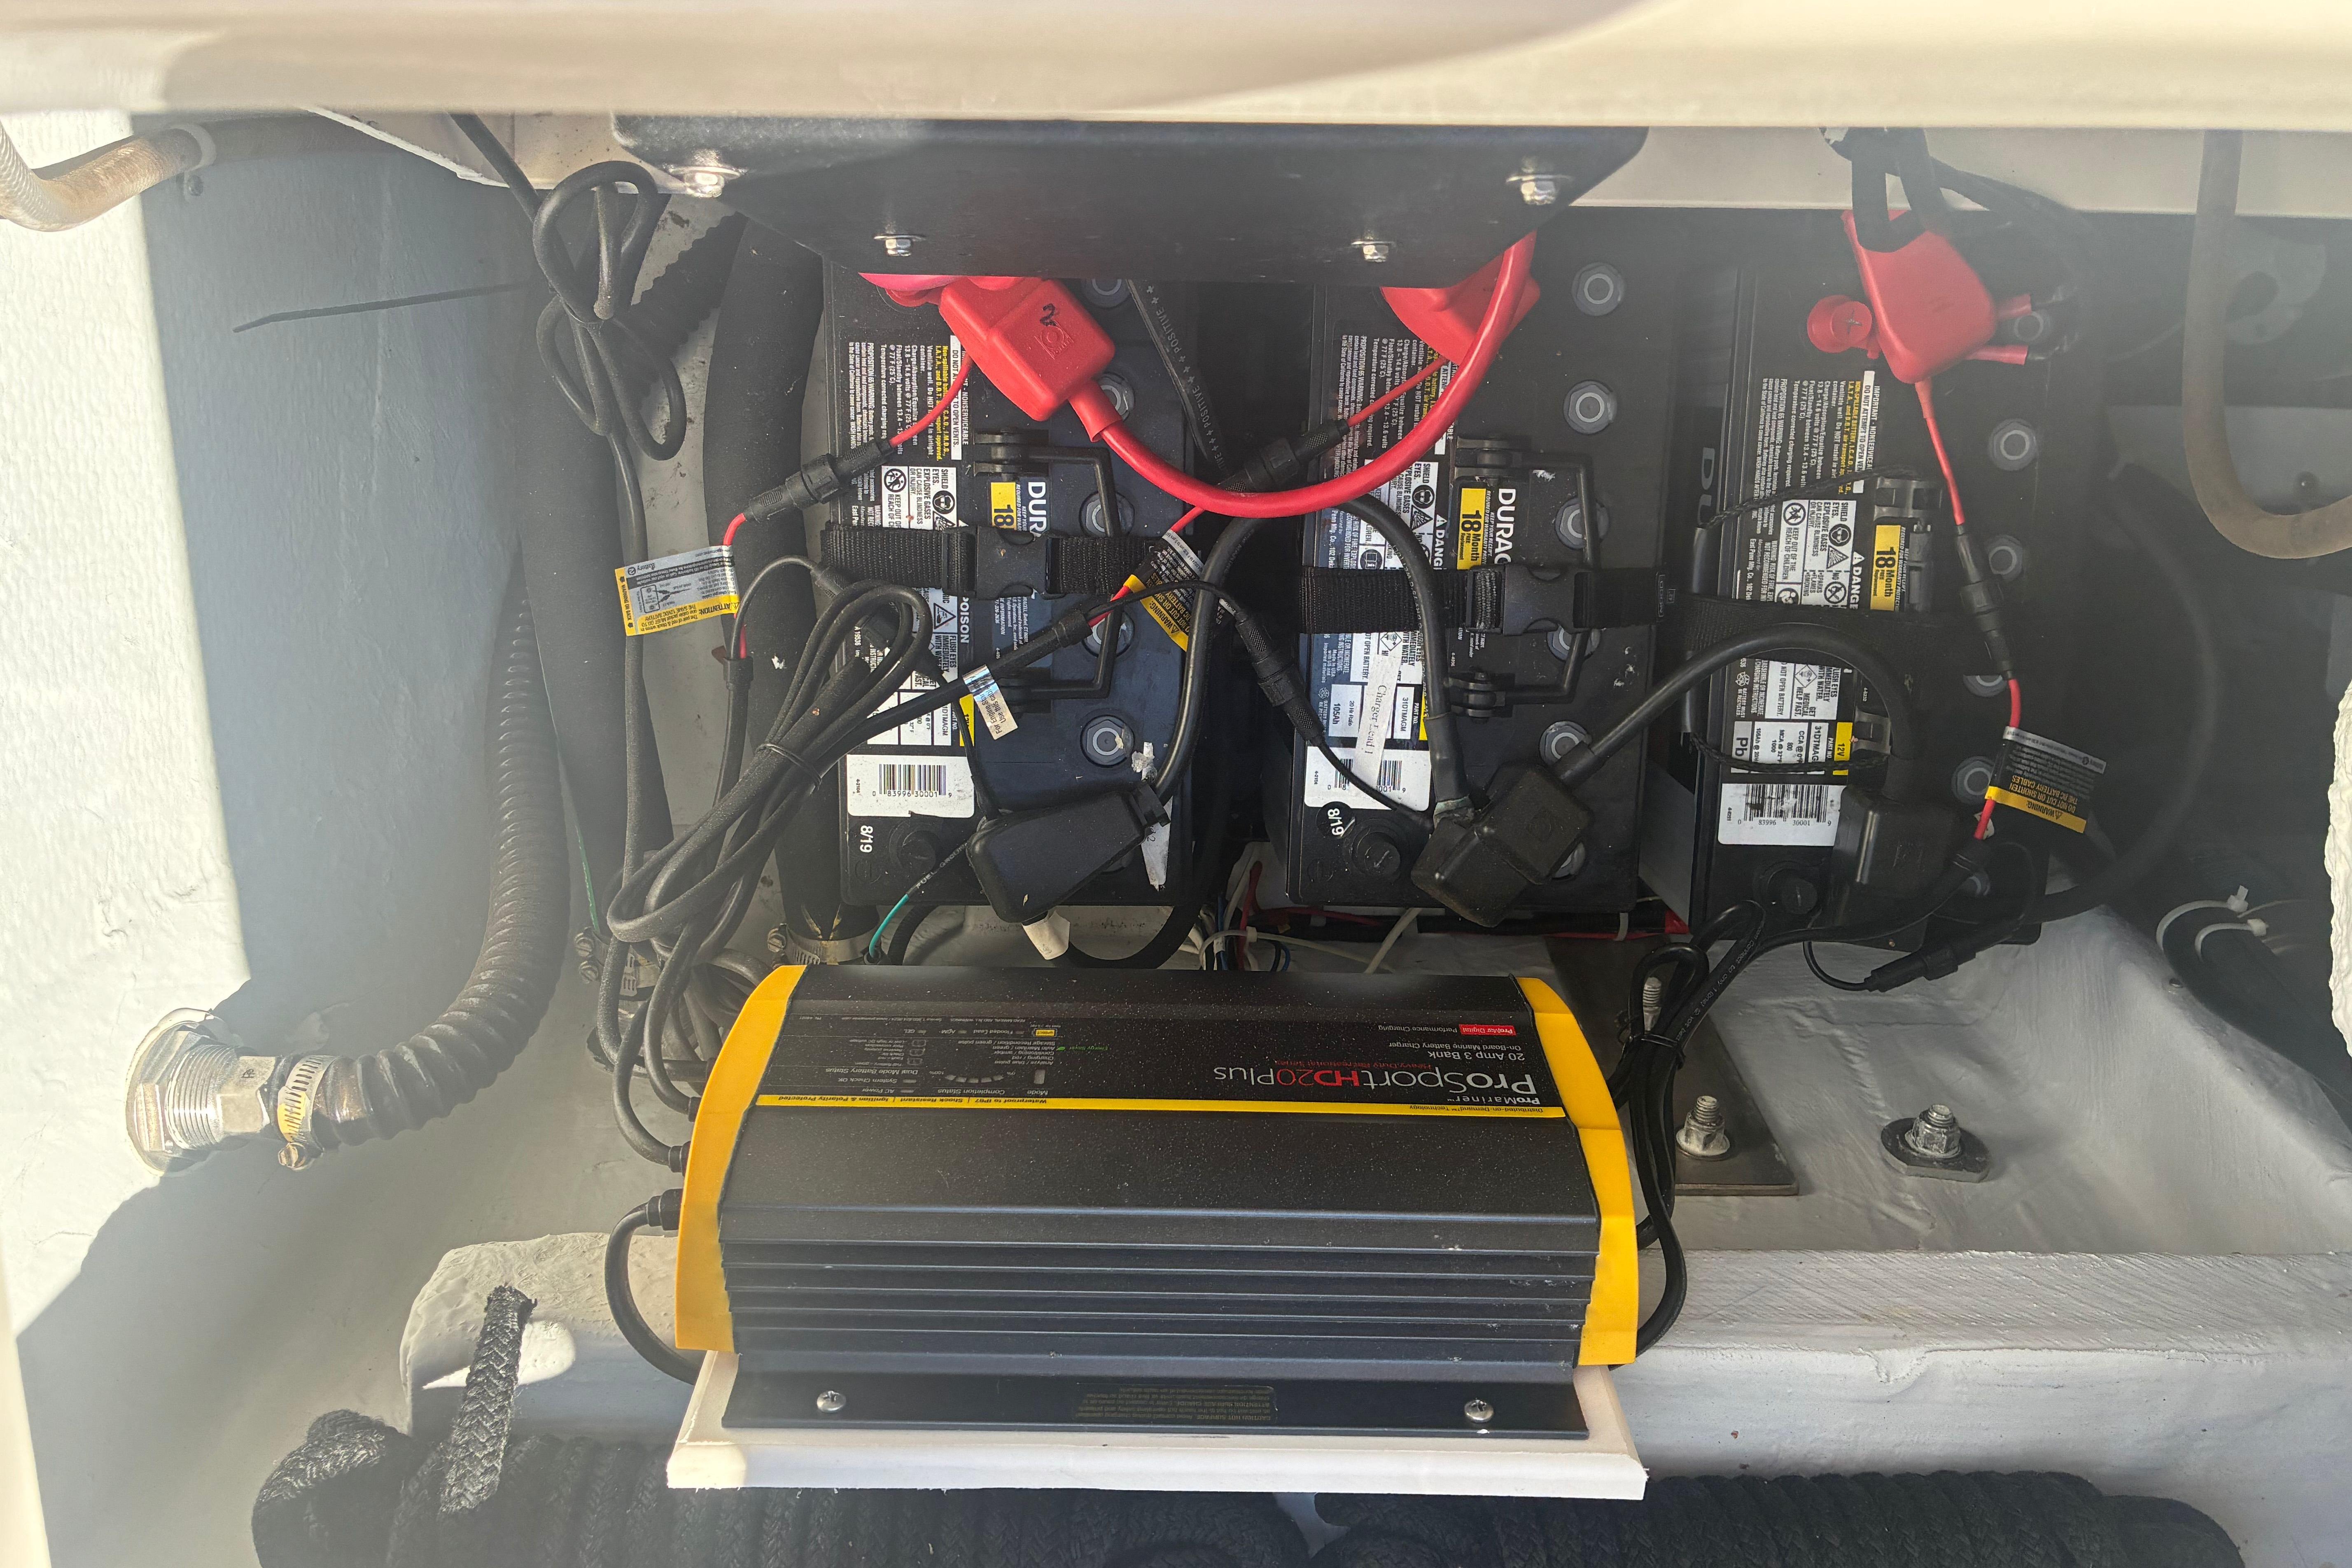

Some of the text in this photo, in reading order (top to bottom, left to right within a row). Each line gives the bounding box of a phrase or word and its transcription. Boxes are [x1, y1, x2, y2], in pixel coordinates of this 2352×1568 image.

[1156, 307, 1181, 354] POSITIVE
[1192, 385, 1211, 428] POSITIVE
[1870, 386, 1879, 420] IMPORTANT
[994, 504, 1014, 526] 18
[1831, 502, 1839, 518] EYES.
[1461, 510, 1481, 560] 18 Month
[1494, 489, 1515, 564] DURAC
[1876, 547, 1896, 597] 18 Month
[1850, 567, 1862, 609] DANGE
[1150, 601, 1174, 629] WARNING:
[1163, 602, 1179, 619] CUT OR
[993, 701, 1001, 712] this
[1371, 685, 1387, 722] Charger
[985, 705, 1003, 734] For Engine
[1735, 737, 1748, 756] Pb
[2012, 775, 2035, 787] CABLES
[1328, 808, 1344, 835] 8/19
[2026, 800, 2055, 817] WARNING:
[860, 825, 873, 853] 8/19
[1428, 1050, 1460, 1059] Bank
[1476, 1051, 1503, 1060] Amp
[1508, 1052, 1524, 1060] 20
